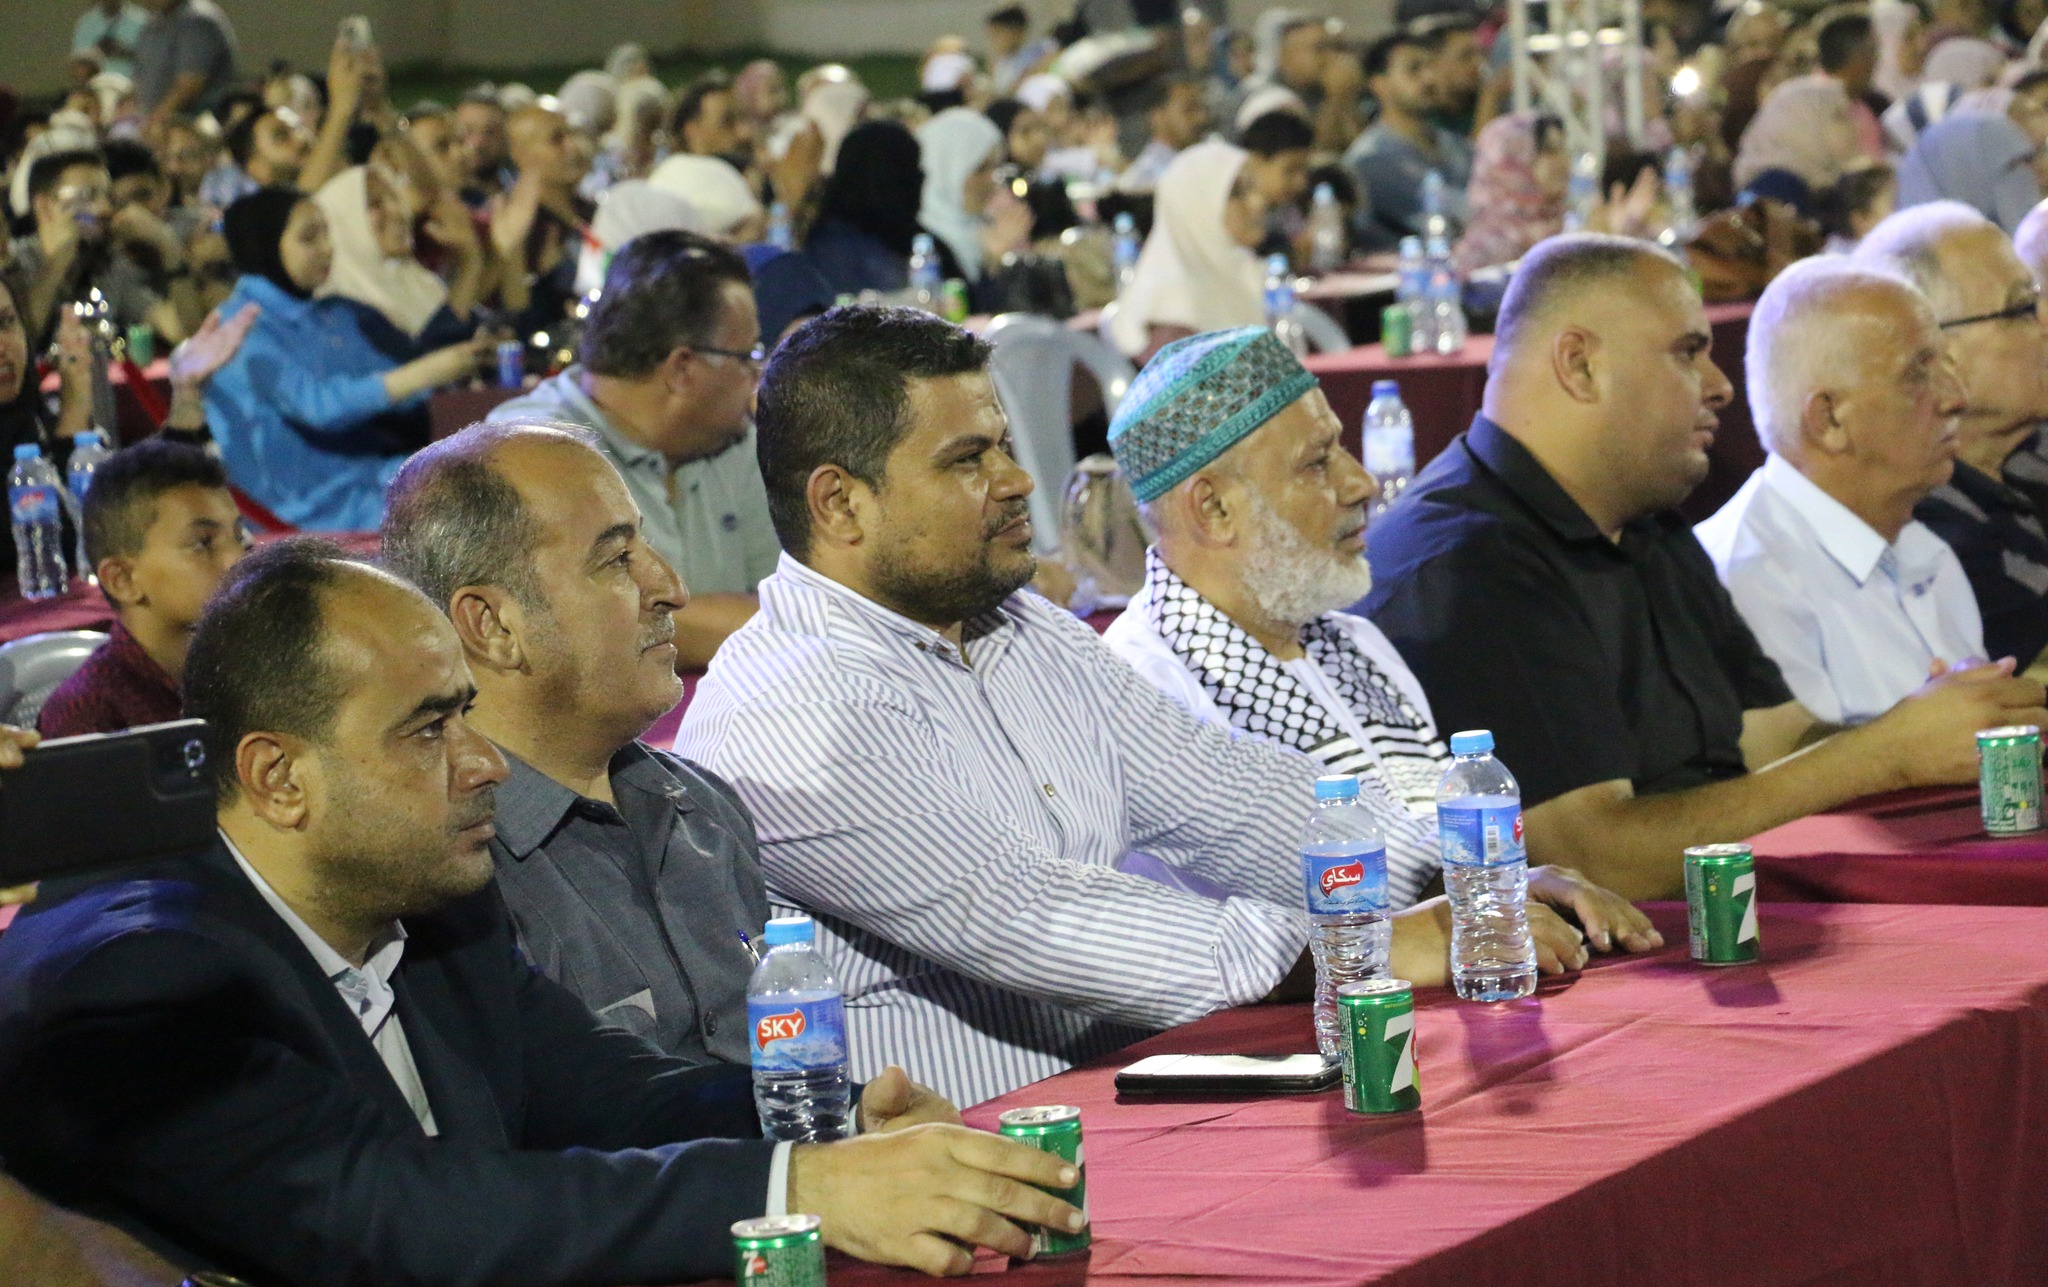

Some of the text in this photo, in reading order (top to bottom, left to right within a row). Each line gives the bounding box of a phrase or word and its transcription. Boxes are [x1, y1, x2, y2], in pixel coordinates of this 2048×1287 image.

[1322, 868, 1361, 891] سكاي
[1732, 871, 1757, 945] 7
[760, 1017, 803, 1038] SKY
[1383, 1009, 1415, 1094] 7
